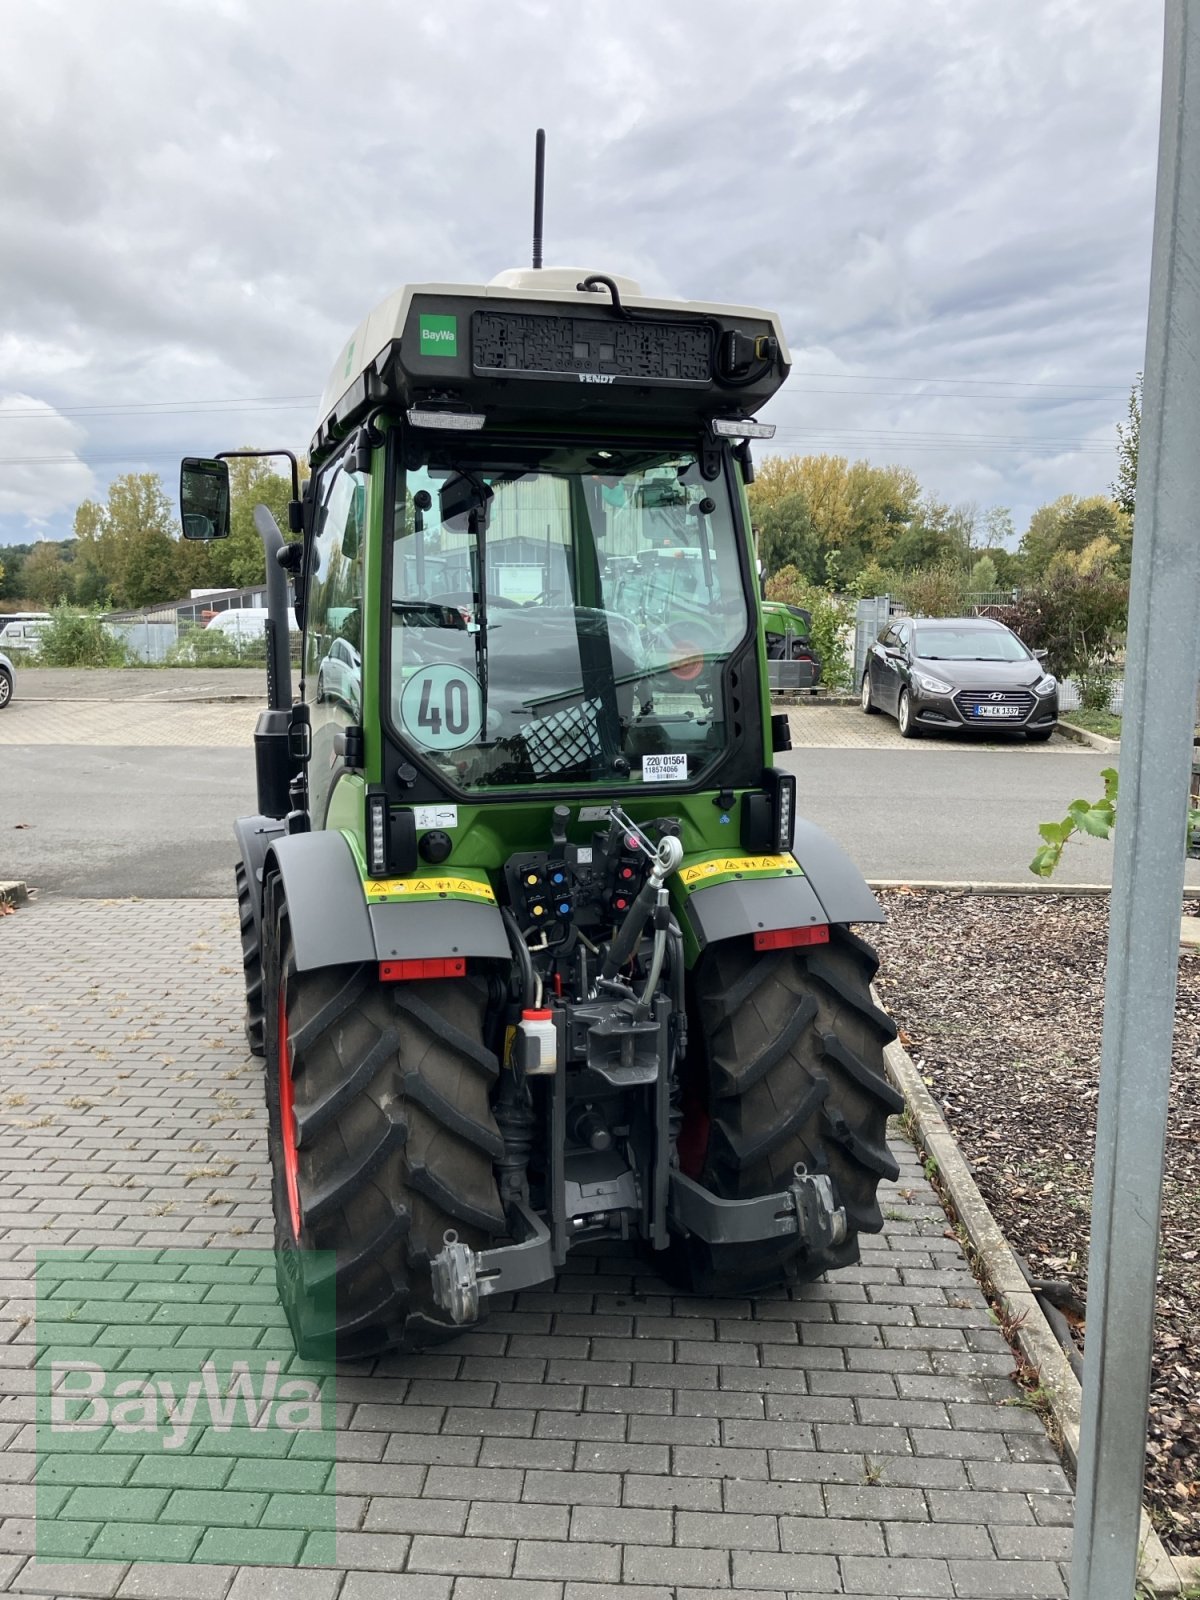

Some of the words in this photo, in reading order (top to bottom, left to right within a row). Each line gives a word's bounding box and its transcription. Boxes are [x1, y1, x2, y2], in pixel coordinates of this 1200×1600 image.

[422, 329, 455, 342] BayWa
[579, 373, 616, 384] FENDT
[417, 678, 470, 735] 40
